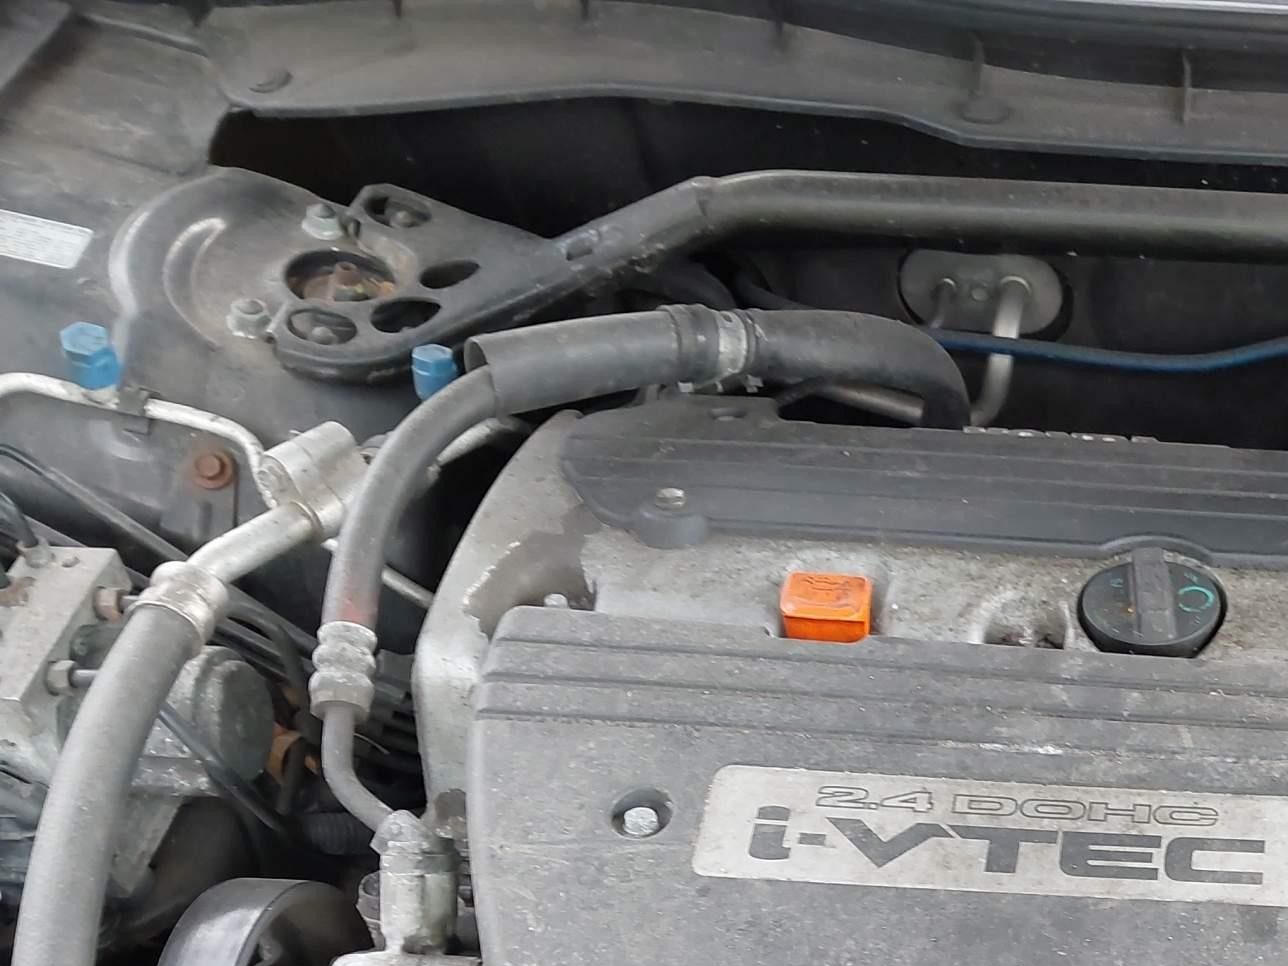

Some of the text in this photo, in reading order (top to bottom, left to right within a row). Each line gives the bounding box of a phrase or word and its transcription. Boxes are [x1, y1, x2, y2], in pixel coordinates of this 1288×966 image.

[815, 784, 1219, 827] 2.4 DOHC
[747, 805, 1266, 885] i-VTEC
